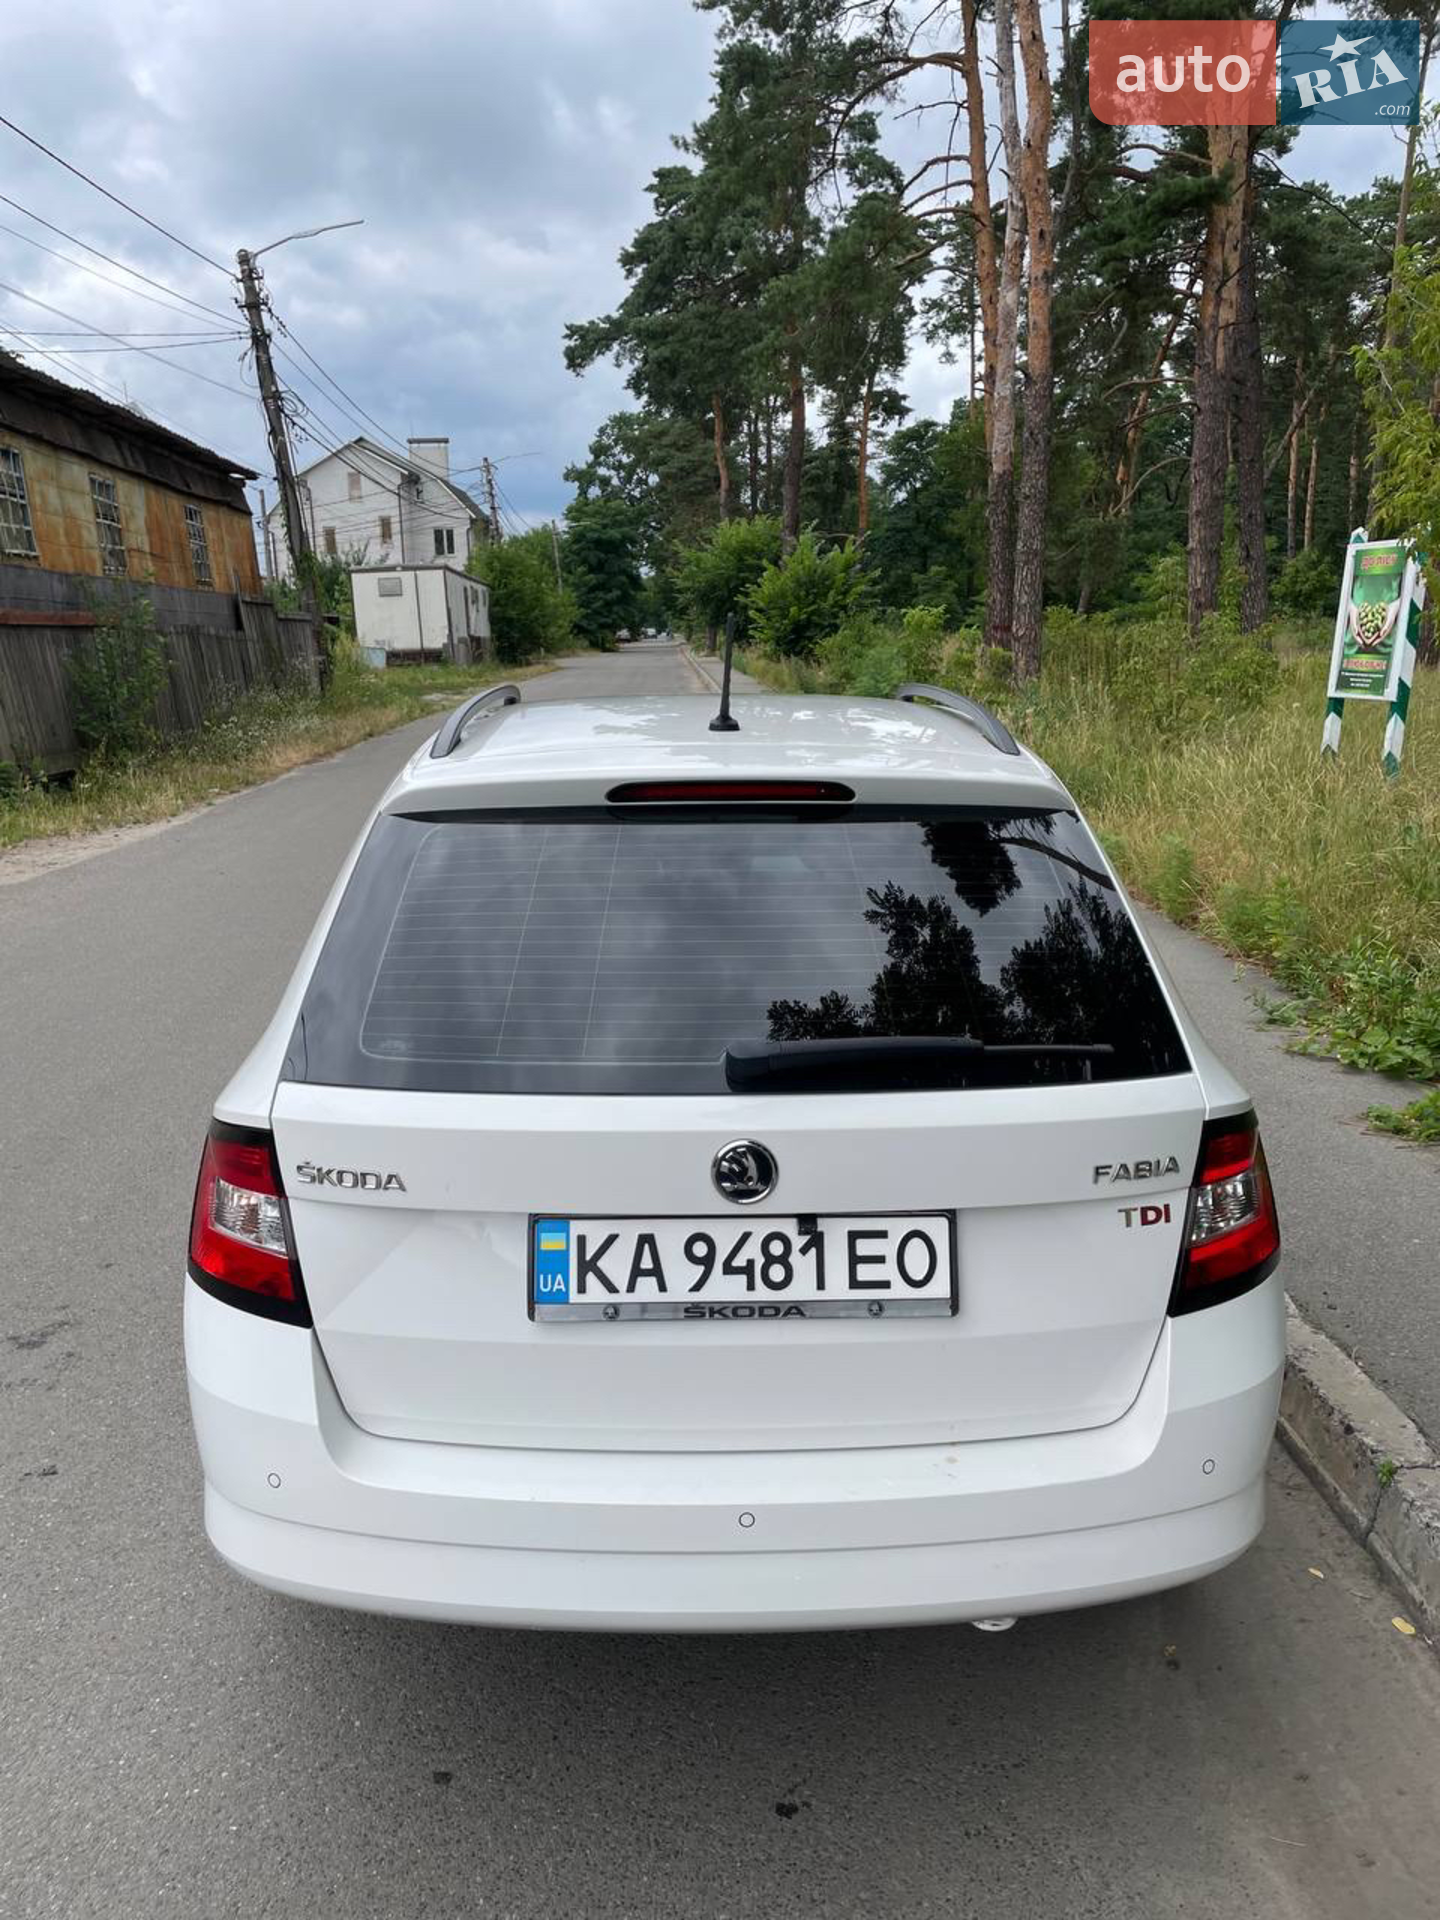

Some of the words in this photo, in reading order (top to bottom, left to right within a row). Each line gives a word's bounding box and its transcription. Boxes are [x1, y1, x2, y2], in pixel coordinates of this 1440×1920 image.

[296, 1160, 408, 1192] ŠKODA
[1093, 1156, 1180, 1185] FABIA
[1117, 1203, 1172, 1228] TDI
[576, 1232, 668, 1294] KA
[683, 1230, 826, 1293] 9481
[539, 1273, 566, 1293] UA
[683, 1301, 807, 1319] ŠKODA
